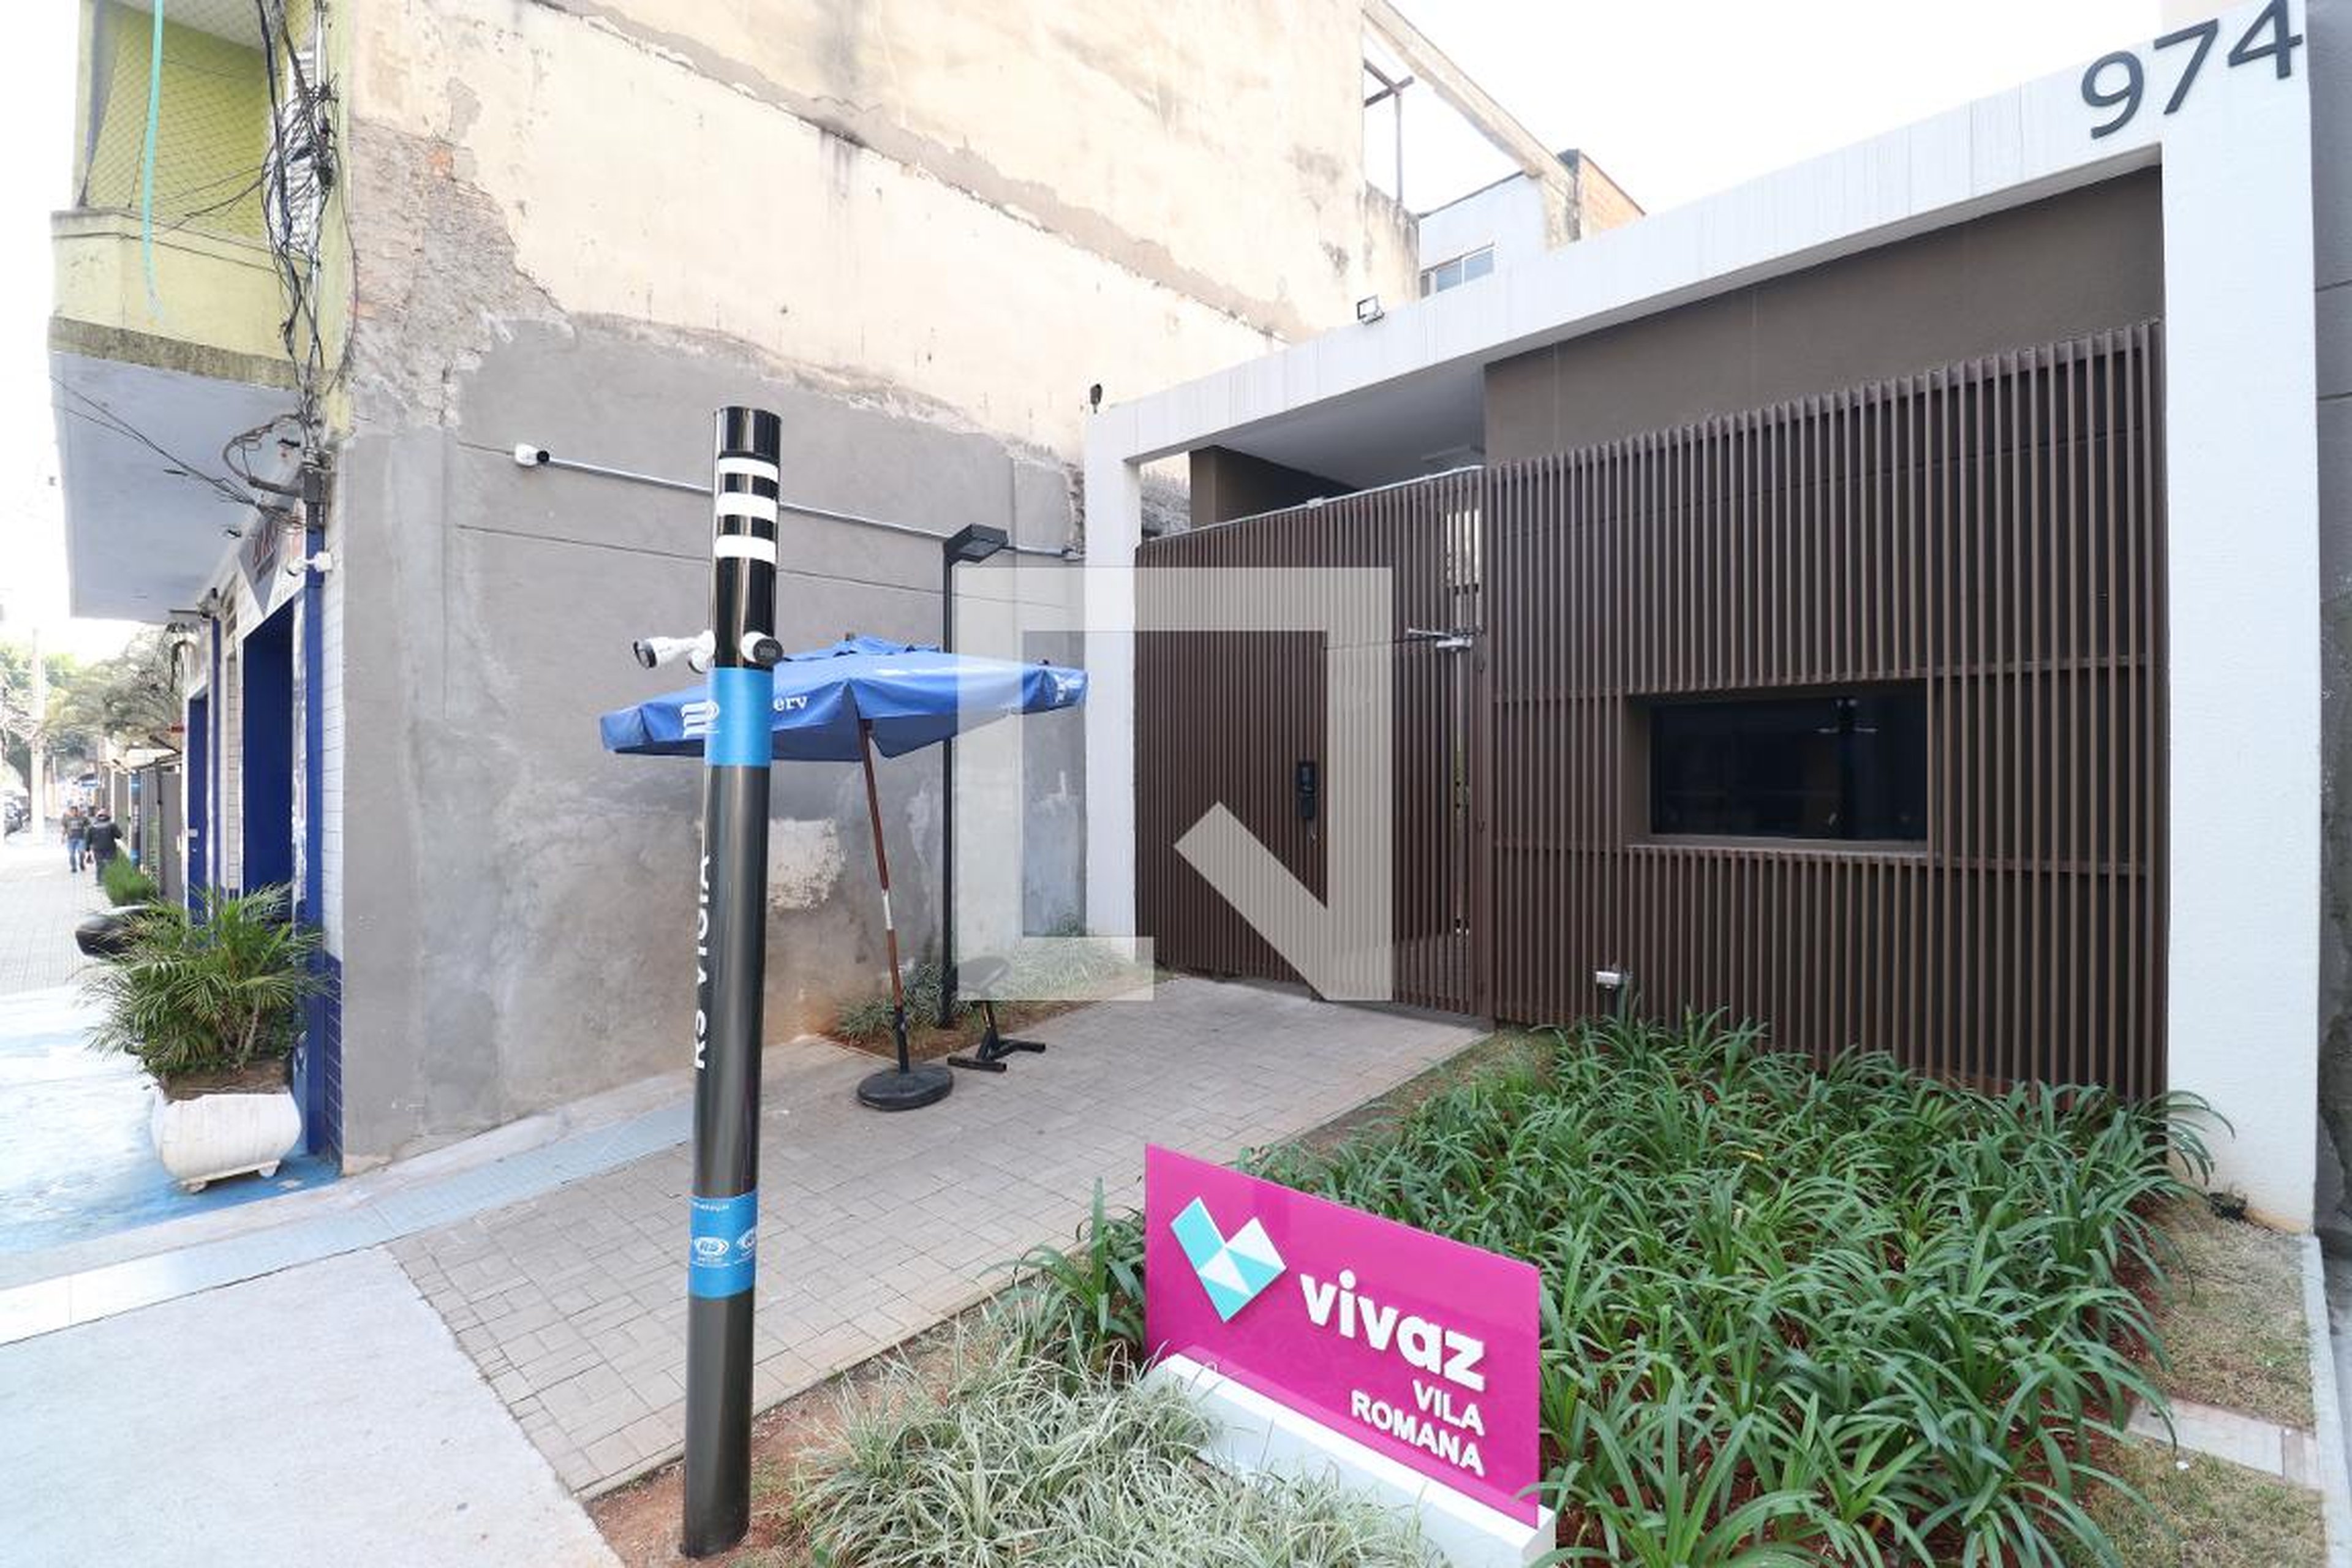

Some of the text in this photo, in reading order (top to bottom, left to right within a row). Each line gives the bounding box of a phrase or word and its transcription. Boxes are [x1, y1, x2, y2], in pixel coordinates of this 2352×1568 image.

[2081, 0, 2303, 140] 974
[1299, 1269, 1485, 1392] vivaz
[1351, 1389, 1485, 1477] ROMANA
[1412, 1379, 1485, 1436] VILA
